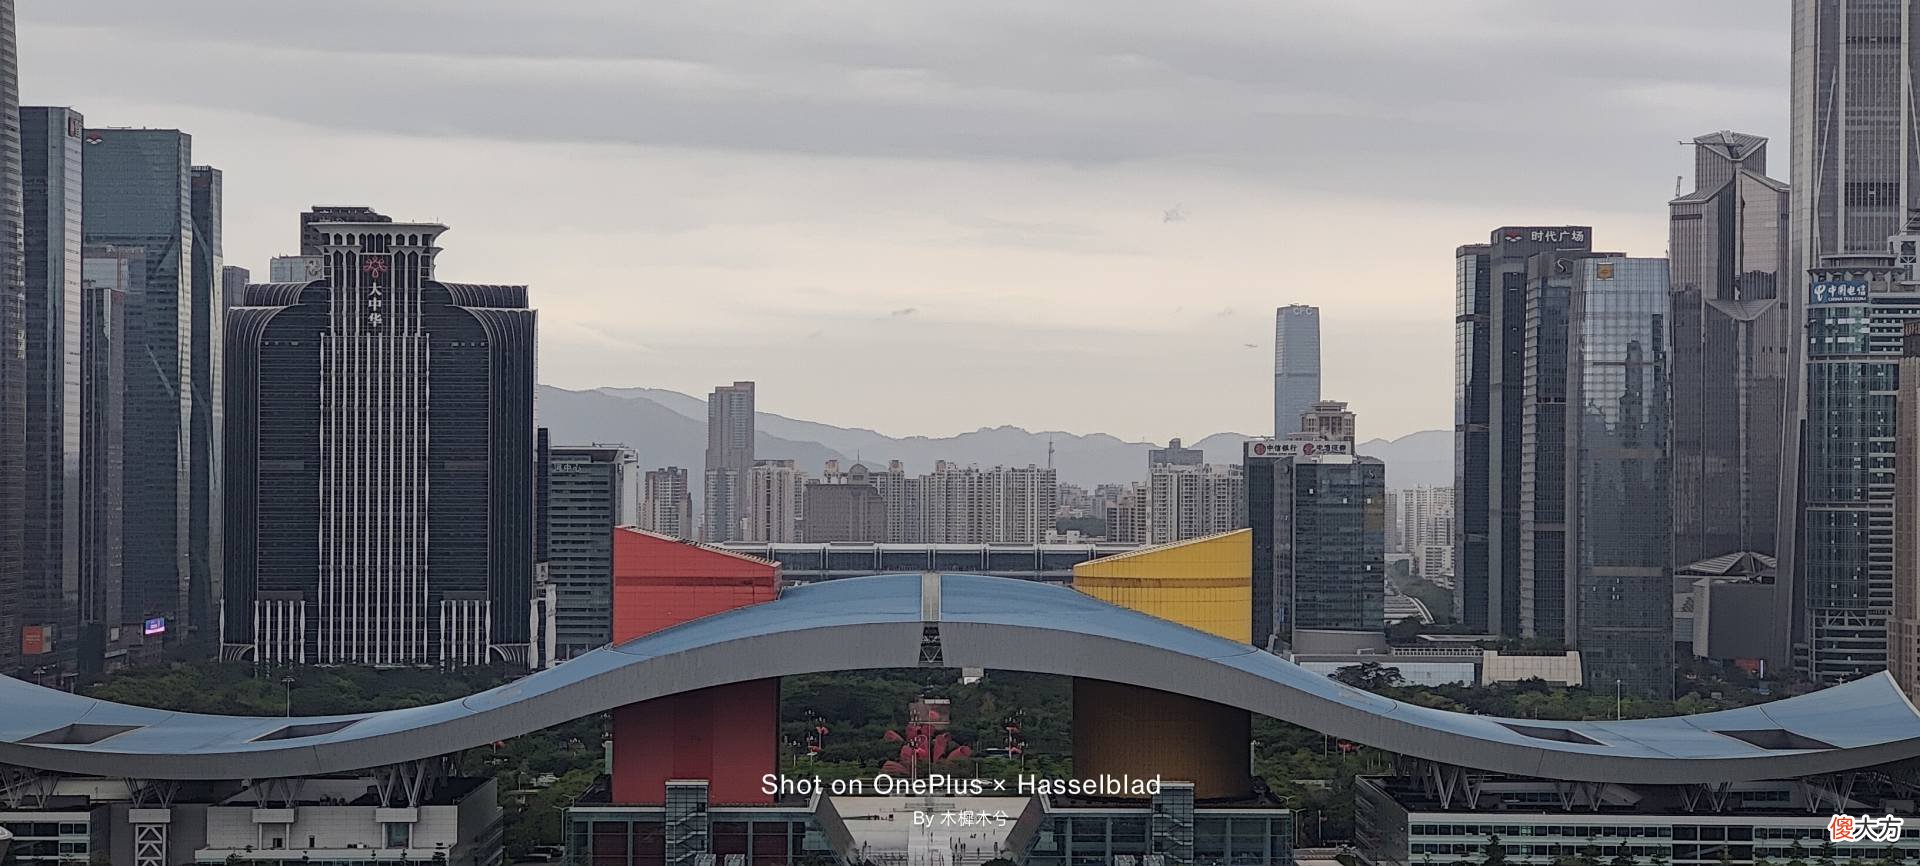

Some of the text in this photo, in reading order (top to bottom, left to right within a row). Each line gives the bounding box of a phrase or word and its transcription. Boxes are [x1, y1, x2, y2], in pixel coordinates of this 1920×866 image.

[1531, 230, 1584, 242] 时代广场
[1828, 284, 1866, 297] 中国电信
[368, 282, 382, 327] 大中华
[1266, 444, 1298, 452] 中信银行
